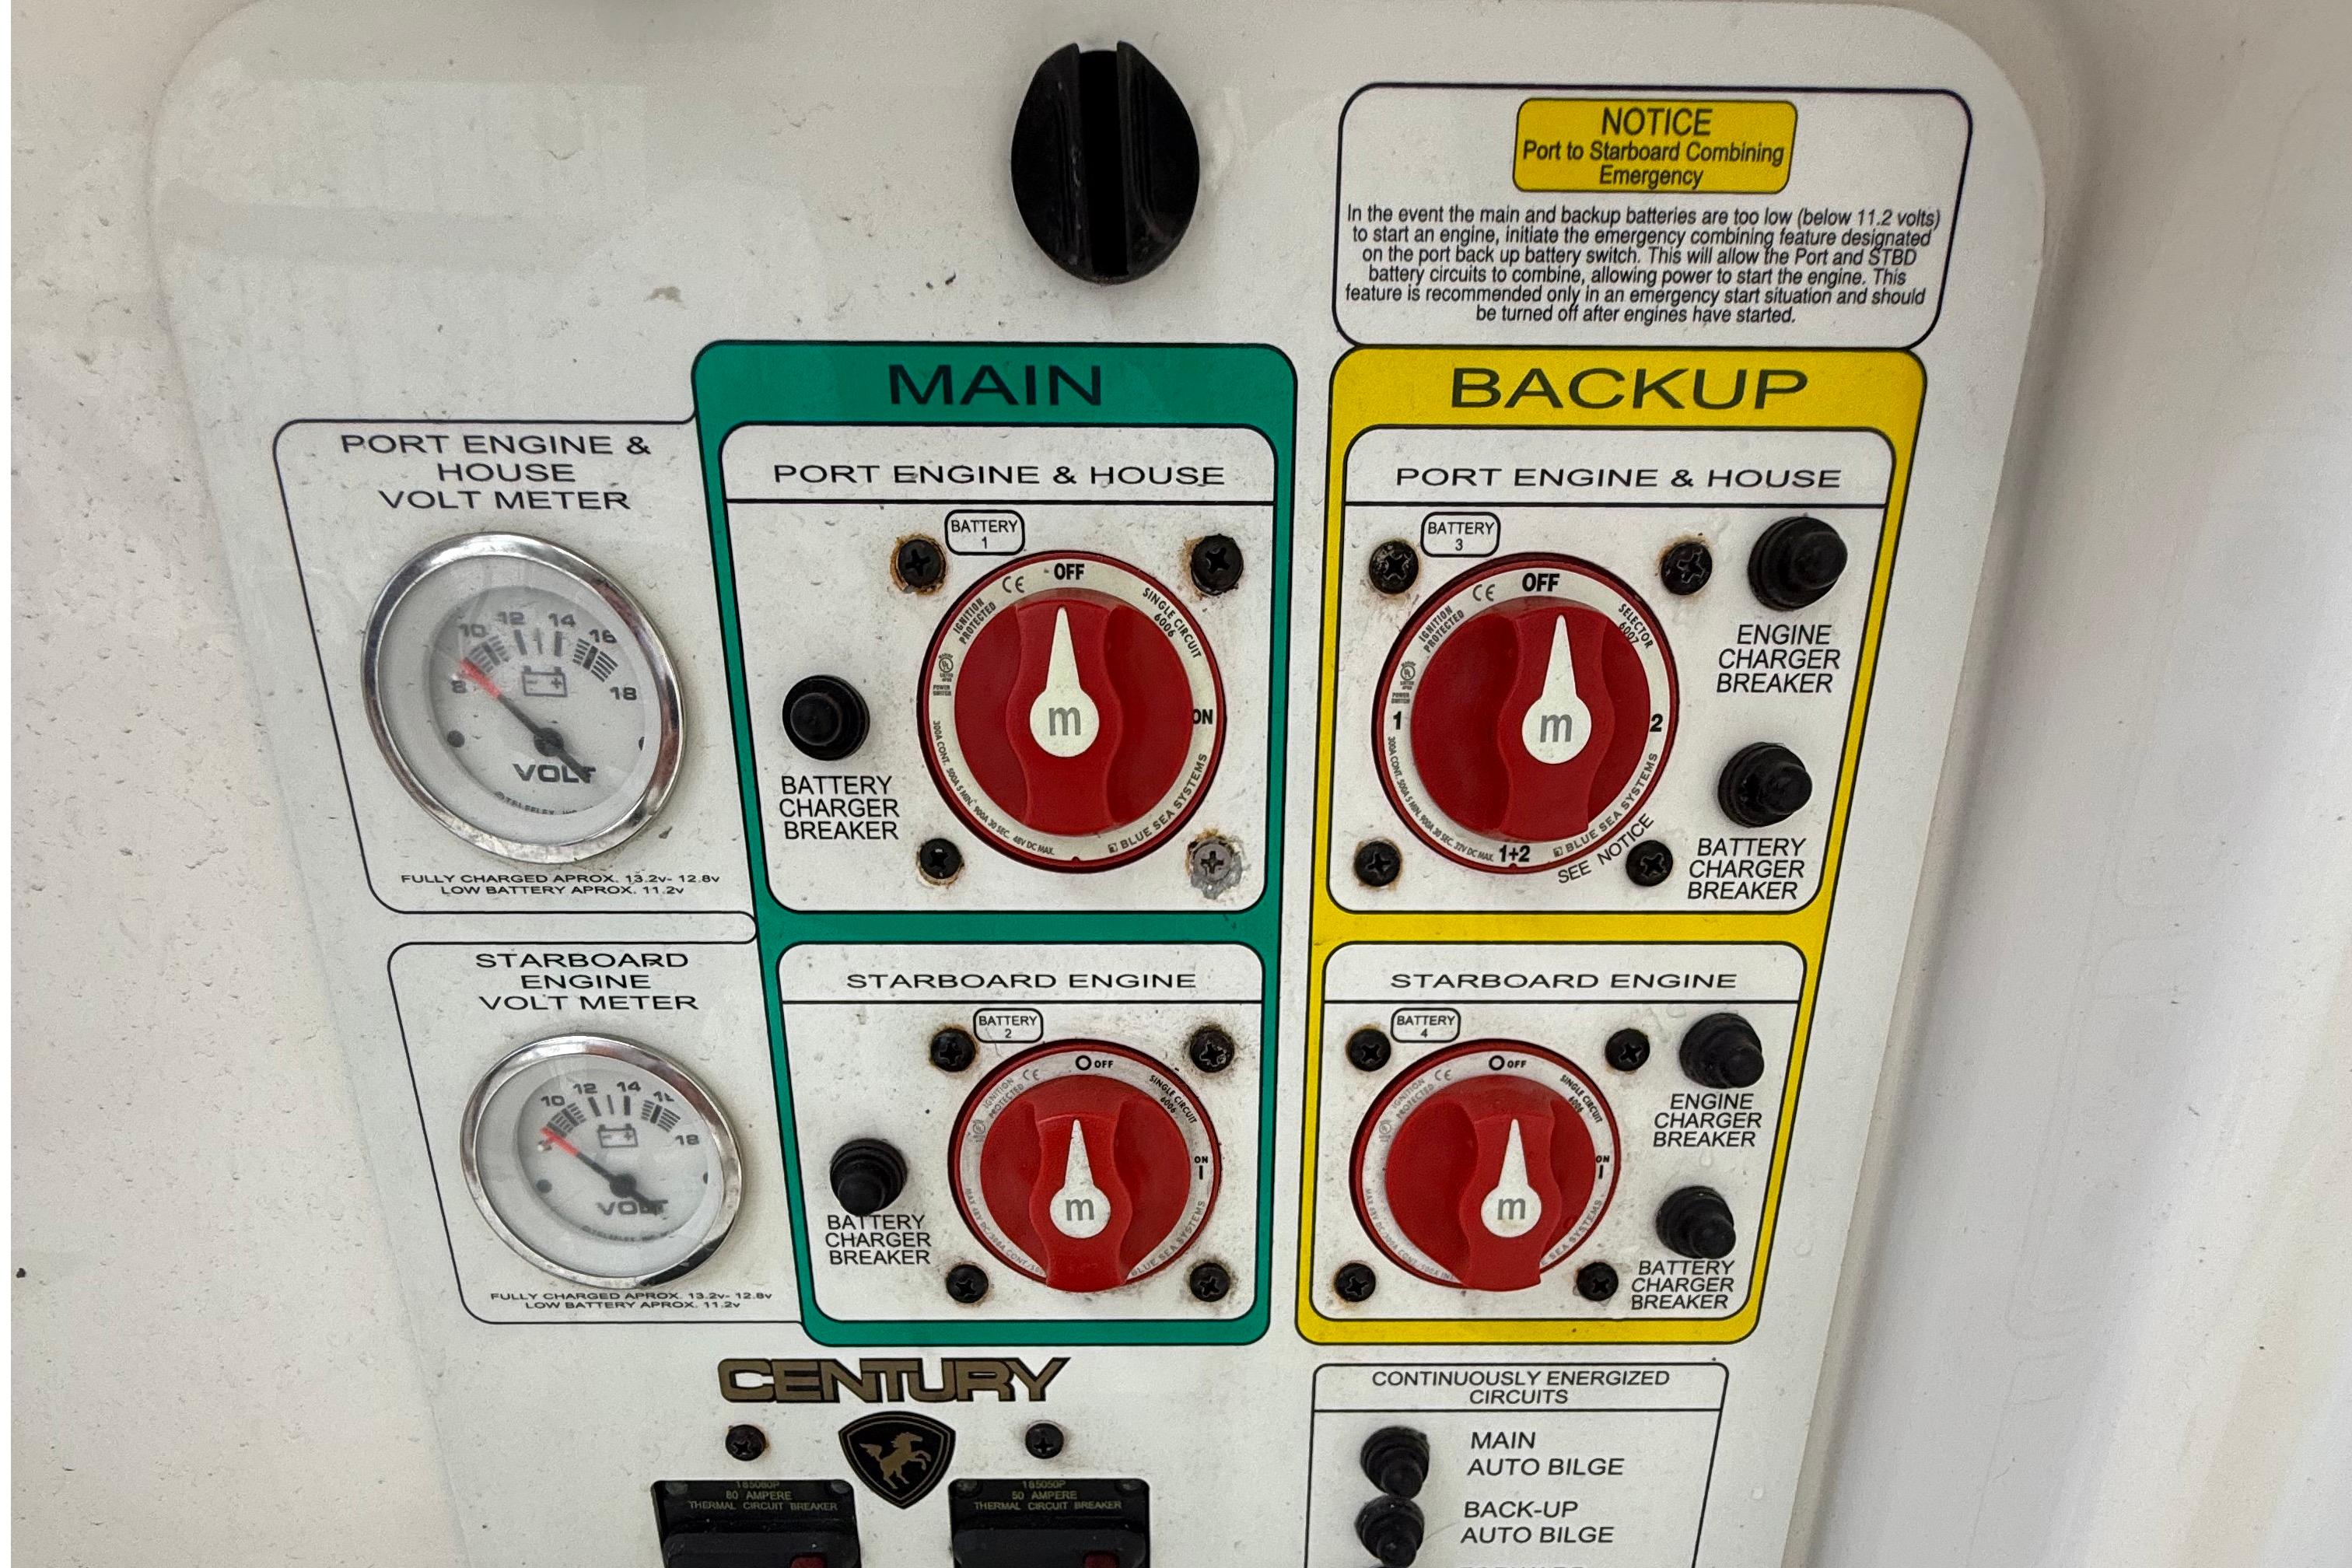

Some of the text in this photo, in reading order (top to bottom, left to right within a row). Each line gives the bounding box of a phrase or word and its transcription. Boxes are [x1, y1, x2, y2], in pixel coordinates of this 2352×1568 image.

[1601, 107, 1713, 136] NOTICE
[1523, 140, 1784, 167] Port to Starboard Combining
[1601, 165, 1703, 190] Emergency
[1347, 205, 1941, 230] In the event the main and backup batteries are too low (below 11.2 volts)
[1353, 226, 1932, 250] to start an engine, initiate the emergency combining feature designated
[1363, 245, 1917, 267] on the port back up battery switch. This will allow the Port and STBD
[1476, 305, 1796, 326] be turned off after engines have started.
[889, 363, 1102, 406] MAIN
[1450, 368, 1808, 409] BACKUP
[341, 435, 652, 454] PORT ENGINE &
[438, 463, 576, 481] HOUSE
[774, 464, 1225, 485] PORT ENGINE & HOUSE
[1396, 467, 1841, 487] PORT ENGINE & HOUSE
[379, 490, 631, 509] VOLT METER
[950, 520, 1018, 534] BATTERY
[1427, 522, 1496, 536] BATTERY
[982, 537, 988, 548] 1
[1455, 538, 1463, 551] 3
[1054, 564, 1084, 580] OFF
[1522, 573, 1559, 593] OFF
[498, 611, 524, 625] 12
[548, 613, 576, 627] 14
[953, 597, 985, 634] IGNITION
[959, 601, 996, 644] PROTECTED
[1143, 587, 1201, 658] SINGLE CIRCUIT
[459, 624, 487, 638] 10
[1153, 613, 1175, 638] 6006
[1618, 603, 1654, 649] SELECTOR
[1619, 622, 1640, 646] 6007
[590, 629, 618, 643] 16
[1737, 625, 1831, 645] ENGINE
[1718, 649, 1841, 670] CHARGER
[1717, 673, 1833, 693] BREAKER
[610, 687, 637, 700] 18
[1193, 709, 1213, 724] ON
[1393, 711, 1402, 730] 1
[1650, 714, 1663, 732] 2
[782, 775, 892, 794] BATTERY
[779, 798, 900, 817] CHARGER
[1120, 754, 1207, 850] BLUE SEA SYSTEMS
[784, 821, 898, 839] BREAKER
[1500, 845, 1530, 862] 1+2
[1559, 812, 1654, 884] SEE NOTICE
[1697, 837, 1805, 857] BATTERY
[1689, 859, 1804, 878] CHARGER
[401, 874, 719, 884] FULLY CHARGED APROX. 13.2v- 12.8v
[441, 886, 684, 895] LOW BATTERY APROX. 11.2v
[1687, 881, 1799, 900] BREAKER
[476, 954, 688, 968] STARBOARD
[521, 975, 651, 989] ENGINE
[847, 974, 1196, 989] STARBOARD ENGINE
[1391, 974, 1737, 989] STARBOARD ENGINE
[479, 996, 699, 1010] VOLT METER
[978, 1016, 1037, 1026] BATTERY
[1396, 1016, 1454, 1026] BATTERY
[1005, 1029, 1011, 1038] 2
[1421, 1029, 1428, 1038] 4
[1670, 1094, 1753, 1110] ENGINE
[1654, 1112, 1762, 1129] CHARGER
[1653, 1131, 1755, 1148] BREAKER
[828, 1214, 925, 1230] BATTERY
[825, 1232, 931, 1248] CHARGER
[830, 1250, 930, 1265] BREAKER
[1639, 1260, 1734, 1276] BATTERY
[1631, 1277, 1734, 1293] CHARGER
[1632, 1295, 1728, 1310] BREAKER
[718, 1356, 1071, 1404] CENTURY
[1372, 1371, 1670, 1386] CONTINUOUSLY ENERGIZED
[1469, 1390, 1569, 1404] CIRCUITS
[1471, 1432, 1535, 1449] MAIN
[1468, 1458, 1625, 1475] AUTO BILGE
[1031, 1491, 1077, 1500] AMPERE
[975, 1502, 1020, 1510] THERMAL
[1028, 1502, 1068, 1510] CIRCUIT
[1465, 1501, 1578, 1517] BACK-UP
[1461, 1526, 1615, 1543] AUTO BILGE
